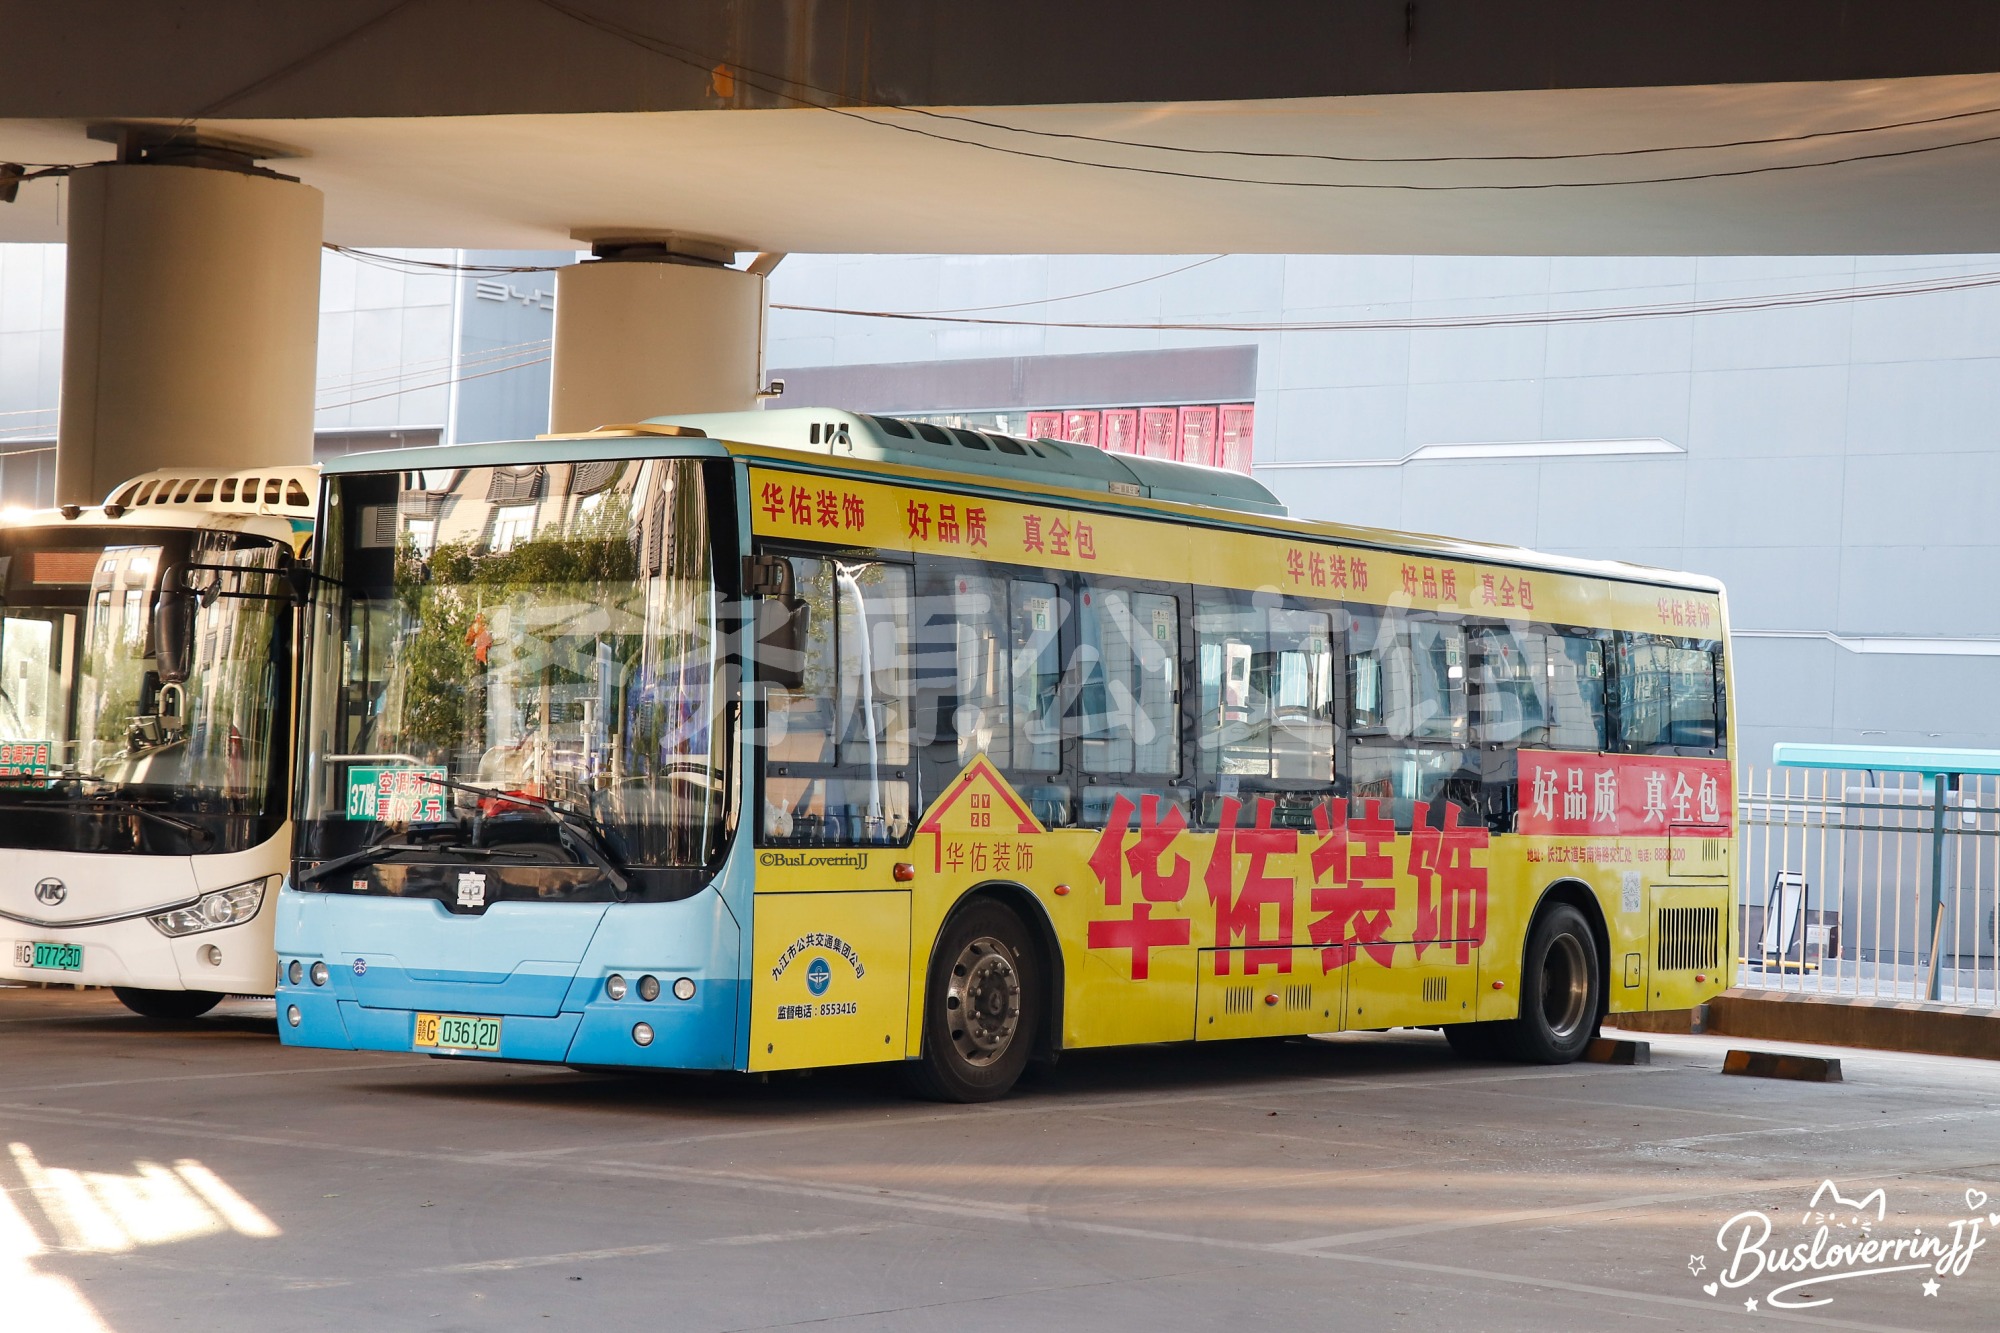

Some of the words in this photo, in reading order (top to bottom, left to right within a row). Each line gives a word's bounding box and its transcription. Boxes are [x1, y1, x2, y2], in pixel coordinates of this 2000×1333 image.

[761, 482, 864, 532] 华佑装饰
[907, 499, 988, 549] 好品质
[1022, 514, 1097, 560] 真全包
[1287, 548, 1368, 592] 华佑装饰
[1401, 562, 1457, 602] 好品质
[1481, 573, 1534, 611] 真全包
[1657, 596, 1710, 629] 华佑装饰
[0, 744, 47, 765] 空调开启
[350, 783, 376, 816] 37路
[379, 771, 443, 795] 空调开启
[1533, 765, 1618, 823] 好品质
[1643, 770, 1720, 823] 真全包
[377, 798, 441, 821] 票价2元
[946, 842, 1033, 873] 华佑装饰
[1088, 792, 1489, 980] 华佑装饰
[772, 933, 865, 981] 九江市公共交通集团公司
